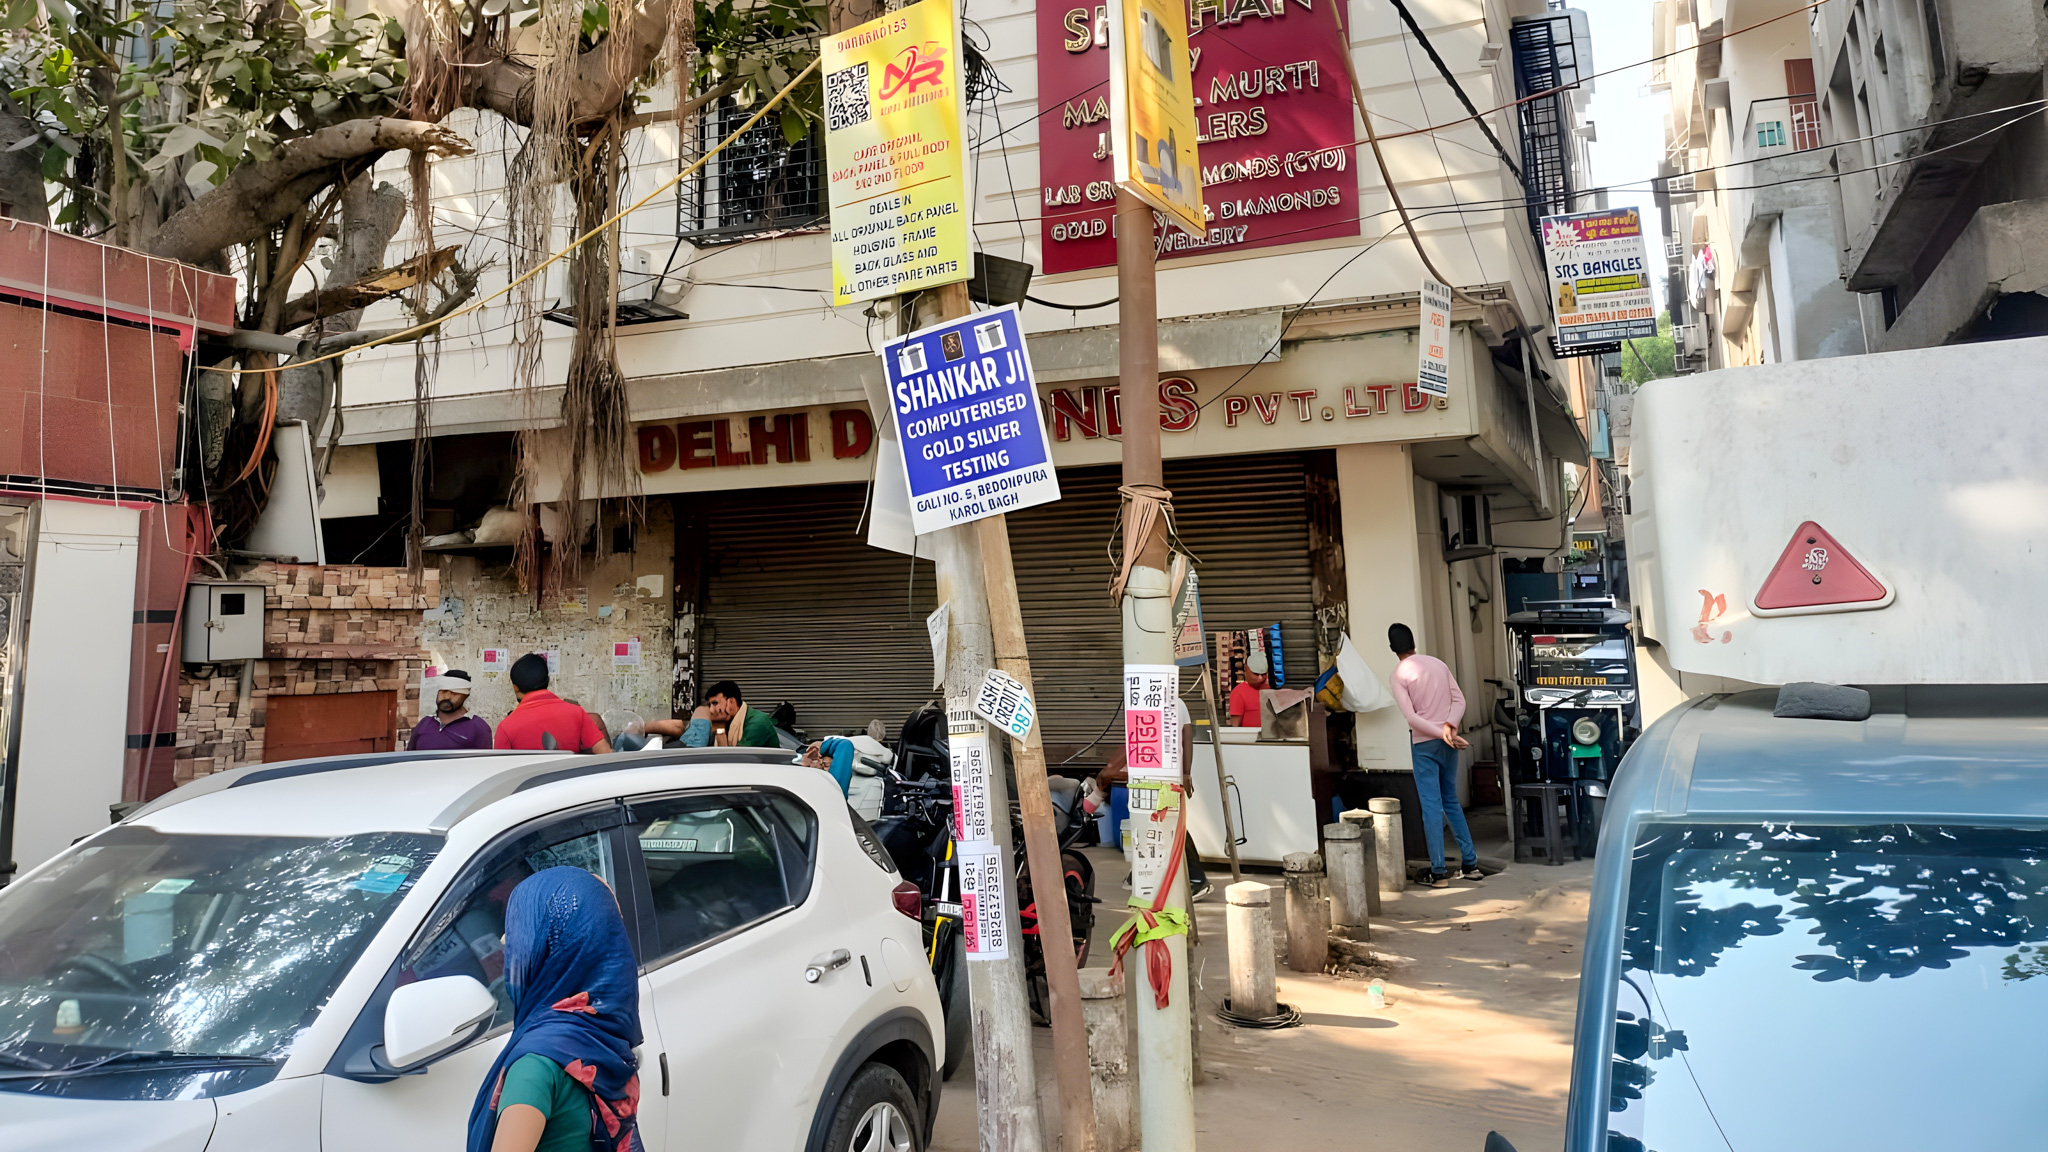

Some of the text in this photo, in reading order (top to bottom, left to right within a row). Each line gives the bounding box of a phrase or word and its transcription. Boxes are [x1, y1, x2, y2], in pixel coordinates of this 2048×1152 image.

[1209, 60, 1319, 104] MURTI
[869, 198, 900, 215] DEALS
[1221, 186, 1341, 220] DIAMONDS
[832, 230, 849, 242] ALL
[896, 211, 924, 226] BACK
[926, 202, 959, 219] PANEL
[1555, 257, 1643, 279] SRS BANGLES
[896, 349, 1025, 415] SHANKAR JI
[637, 412, 811, 474] DELHI
[1223, 389, 1334, 427] PVT.
[1343, 382, 1449, 418] LTD.
[906, 392, 1027, 439] COMPUTERISED
[922, 420, 1021, 460] GOLD SILVER
[942, 449, 1010, 481] TESTING
[917, 498, 941, 512] GALI
[943, 491, 963, 504] NO.
[949, 492, 1020, 521] KAROL BAGH
[978, 681, 999, 715] CASH
[994, 686, 1020, 727] CREDIT
